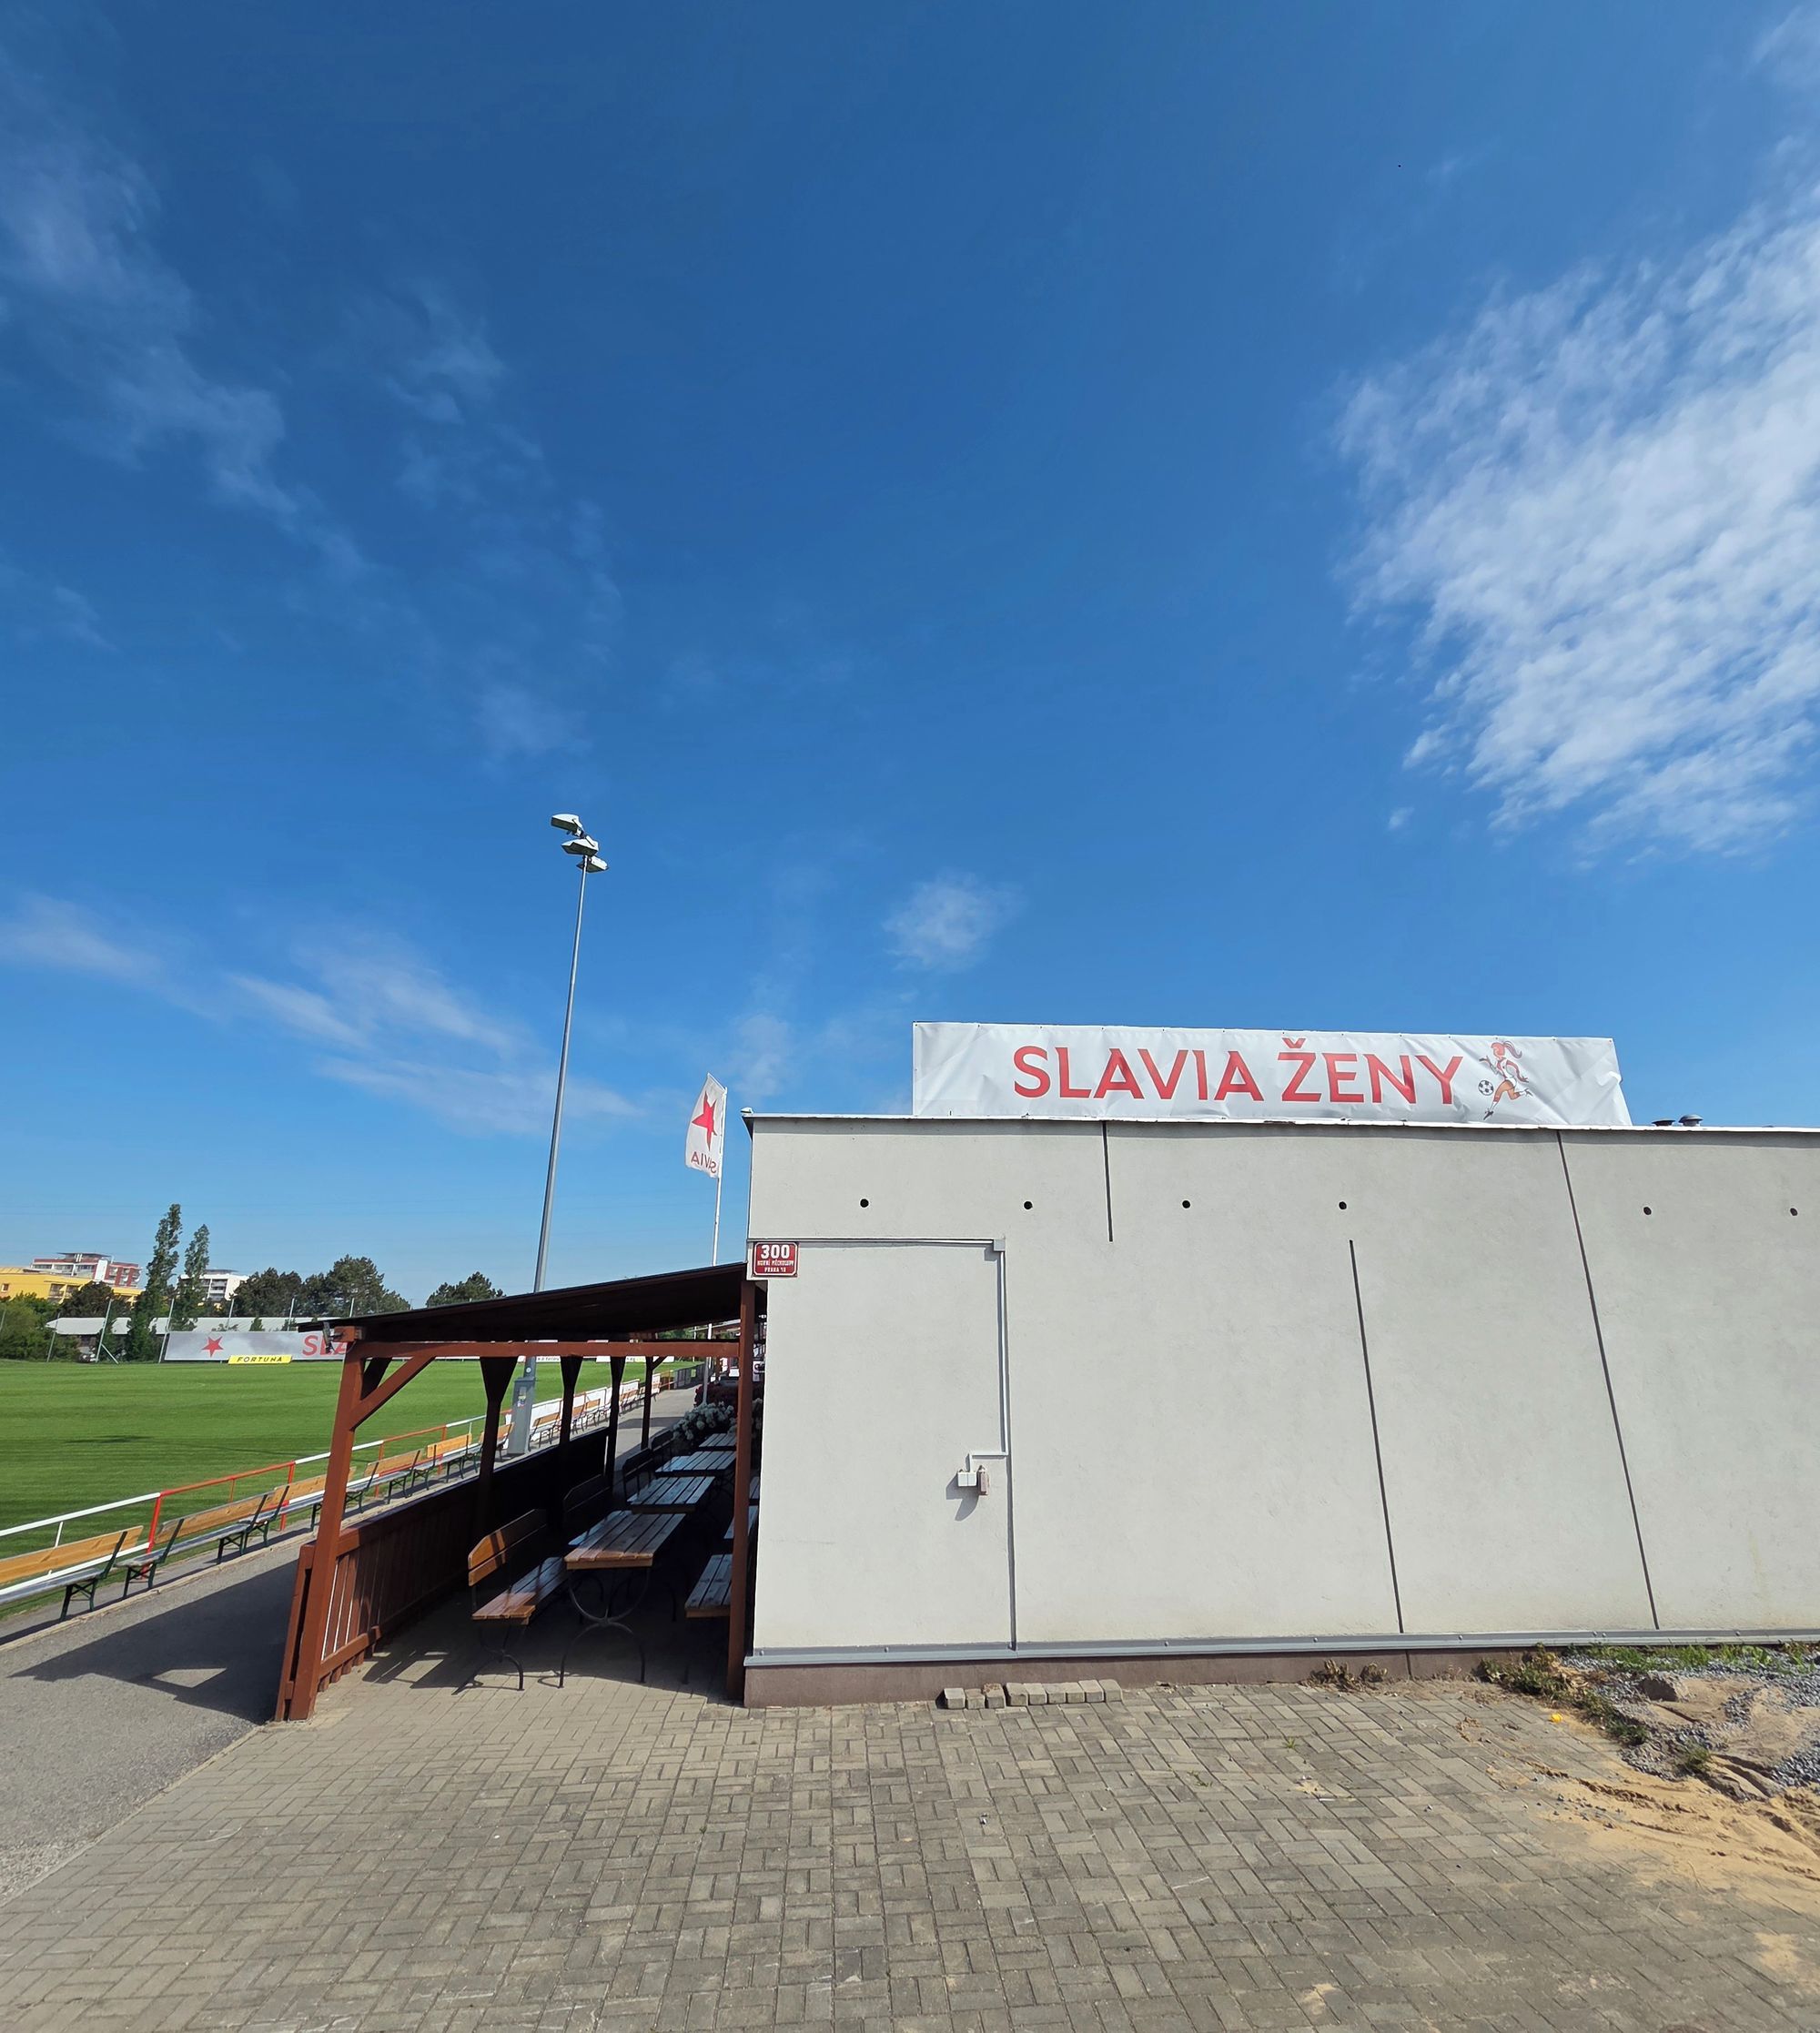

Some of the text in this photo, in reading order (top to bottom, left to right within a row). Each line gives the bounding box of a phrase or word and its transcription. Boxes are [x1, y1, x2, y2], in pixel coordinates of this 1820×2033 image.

[1013, 1037, 1464, 1105] SLAVIA ŽENY
[761, 1244, 790, 1259] 300
